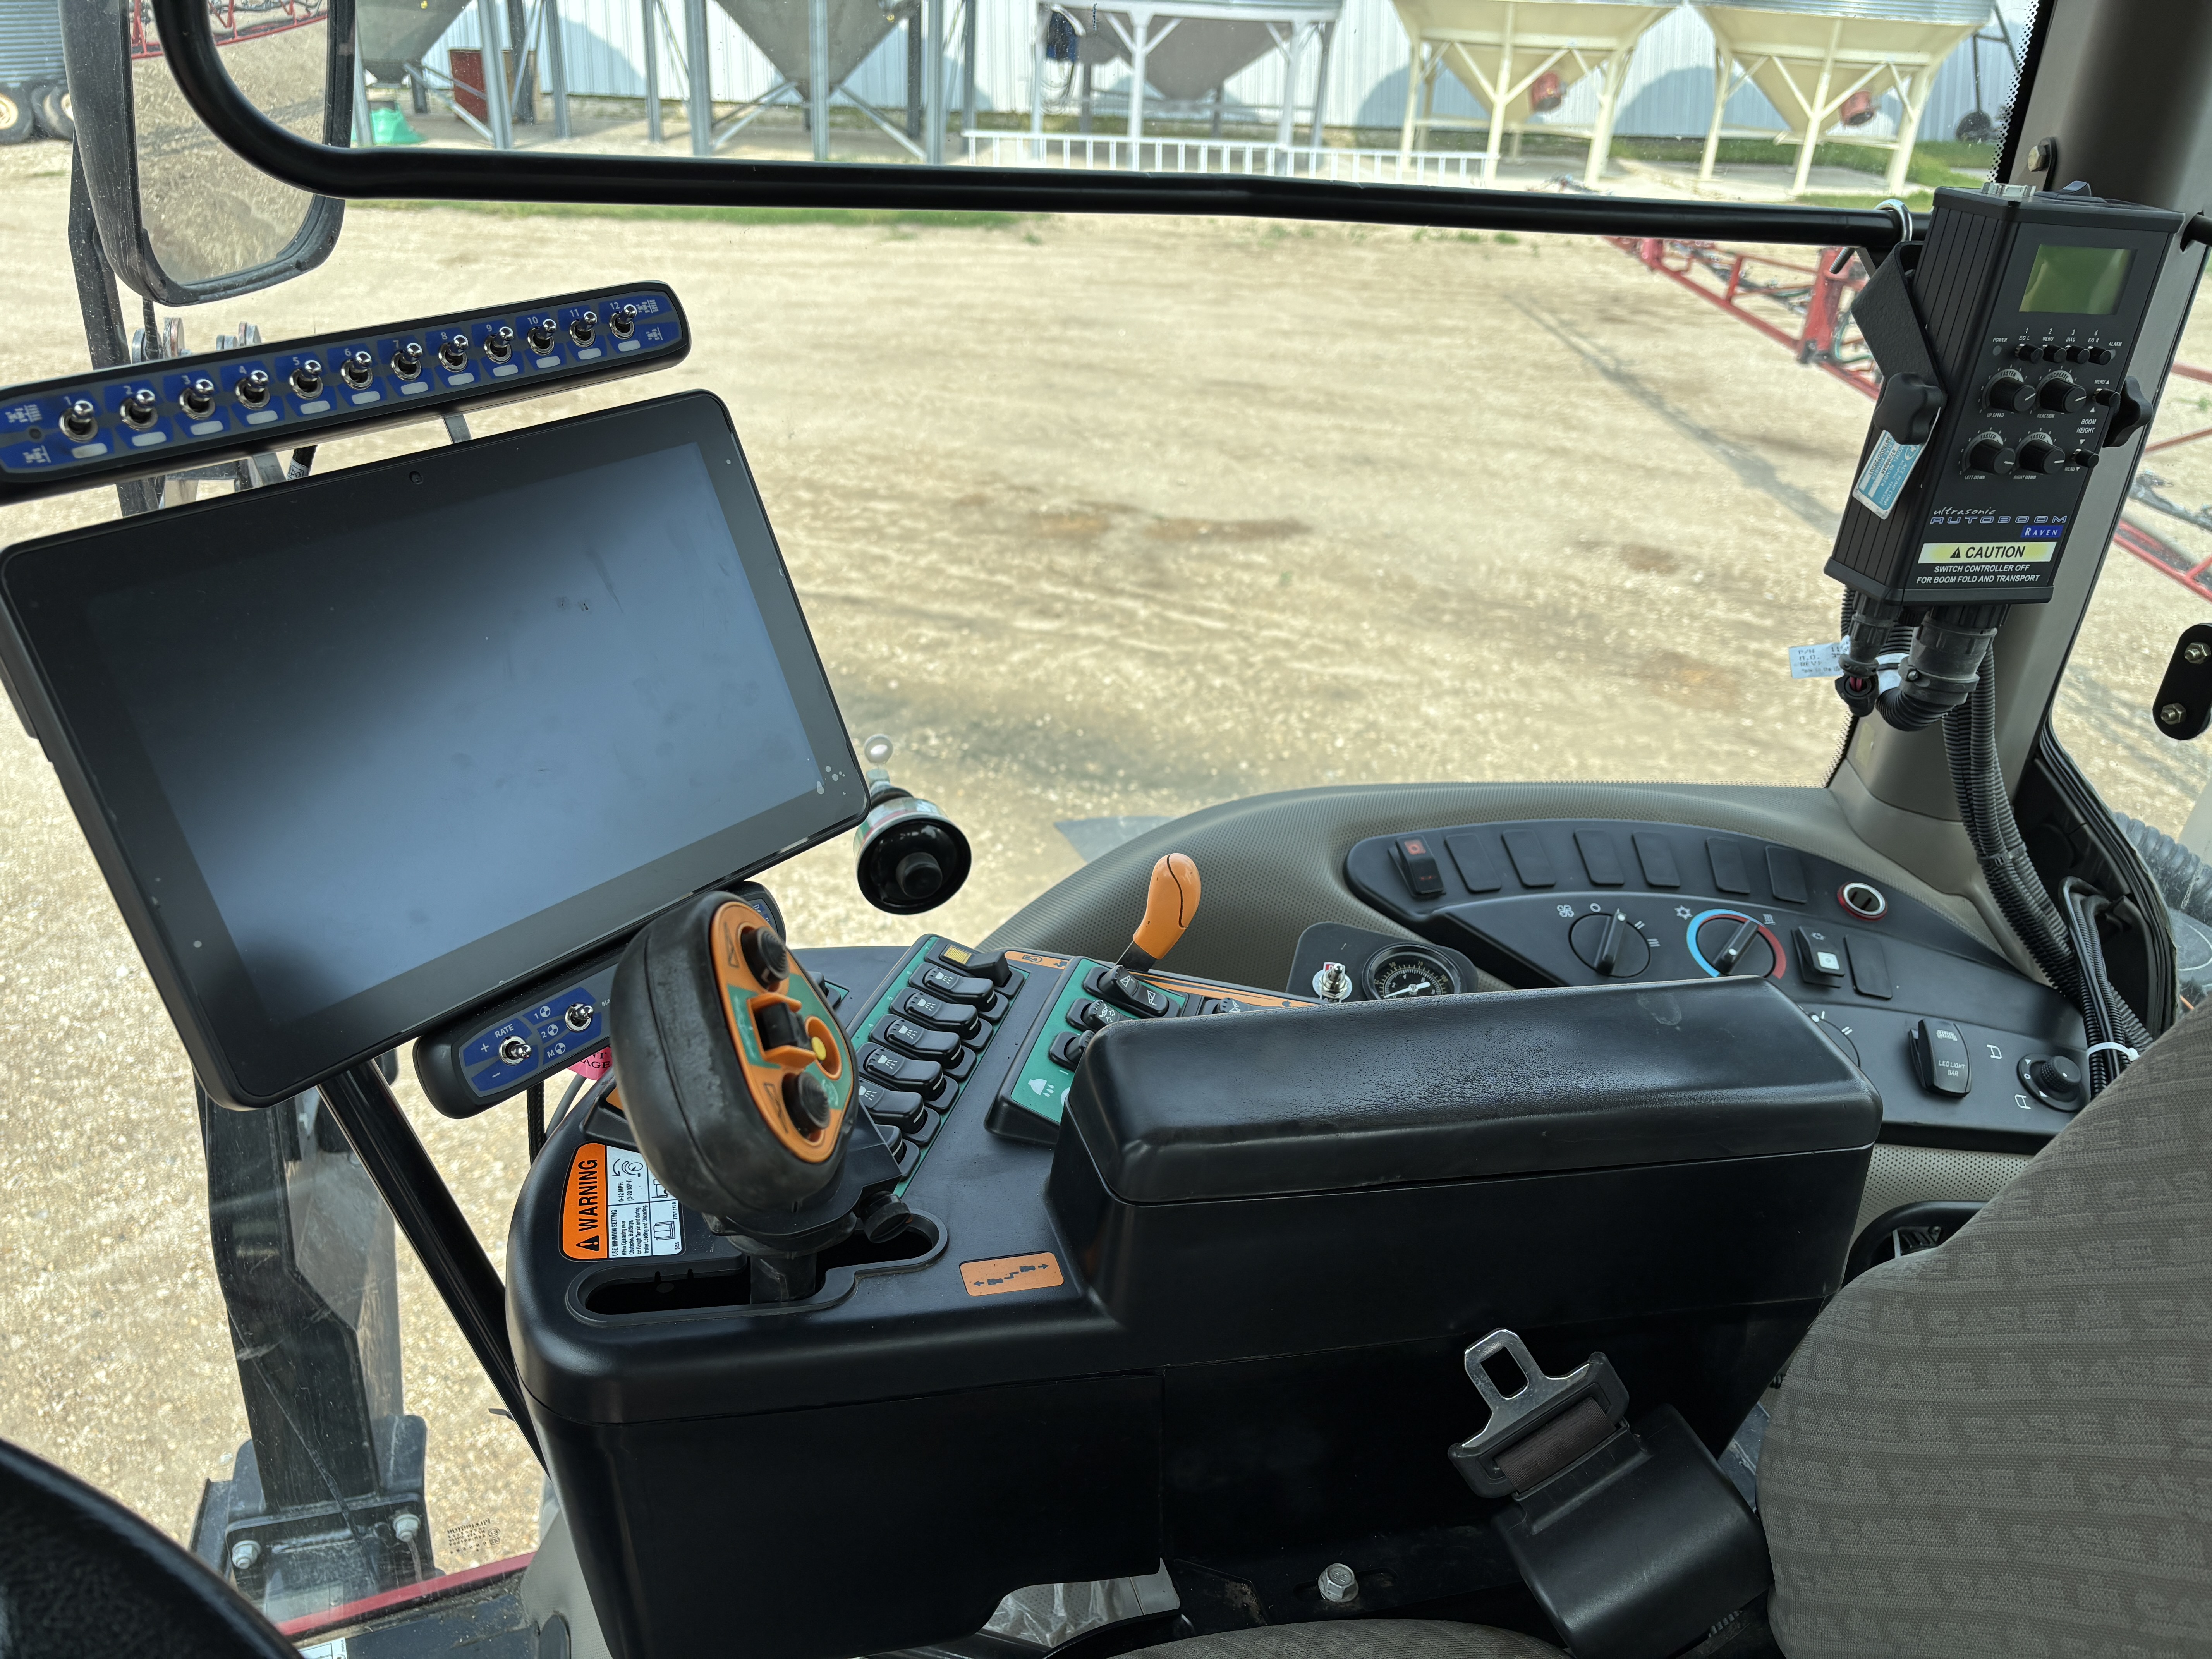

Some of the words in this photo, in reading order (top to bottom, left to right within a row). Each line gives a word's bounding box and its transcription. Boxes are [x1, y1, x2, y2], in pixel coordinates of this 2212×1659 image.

[610, 302, 620, 310] 12
[293, 357, 300, 366] 5
[239, 366, 247, 374] 4
[182, 375, 190, 384] 3
[123, 385, 134, 395] 2
[64, 396, 72, 405] 1
[1934, 507, 1996, 515] ultrasonic
[1930, 516, 2068, 524] AUTOBOOM
[2025, 527, 2058, 536] RAVEN
[1965, 546, 2025, 558] CAUTION
[494, 1024, 515, 1038] RATE
[546, 1049, 555, 1058] M
[1950, 1062, 1966, 1070] LIGHT
[578, 1159, 598, 1231] WARNING
